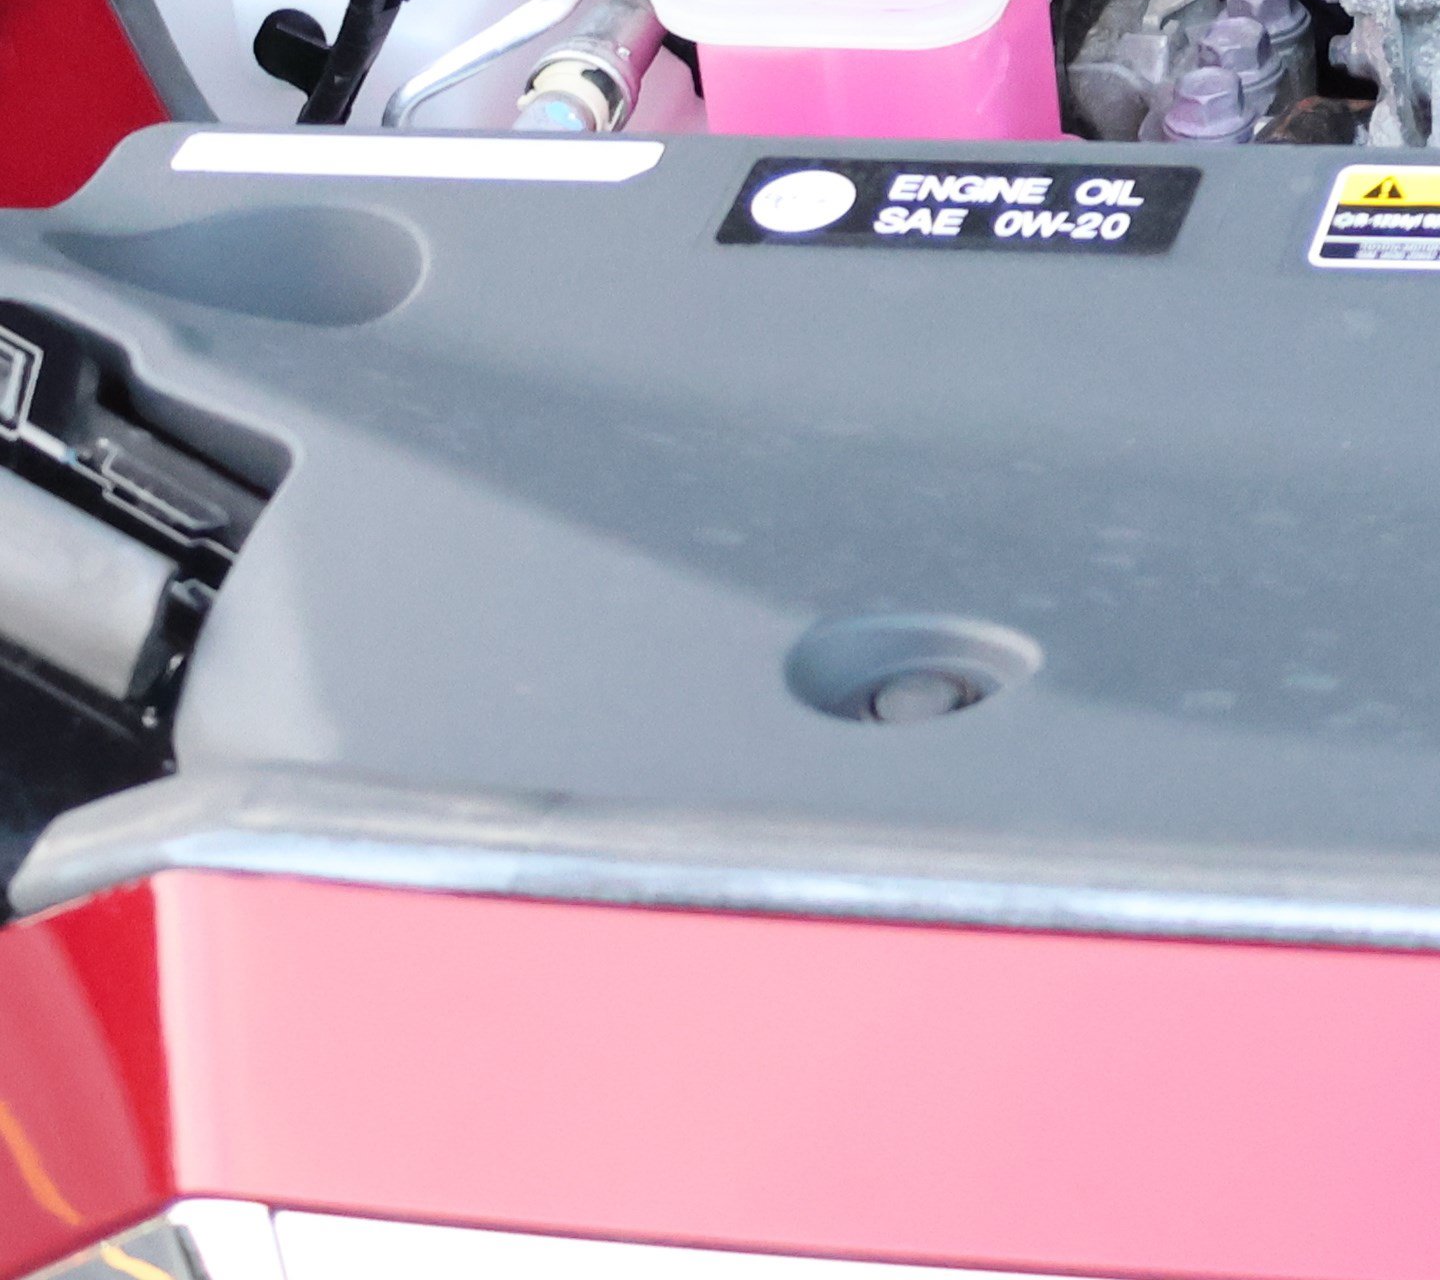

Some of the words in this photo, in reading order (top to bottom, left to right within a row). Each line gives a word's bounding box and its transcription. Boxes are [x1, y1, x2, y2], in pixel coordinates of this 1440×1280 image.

[887, 173, 1053, 205] ENGINE
[1074, 177, 1146, 207] OIL
[872, 206, 970, 236] SAE
[993, 210, 1132, 241] 0W-20
